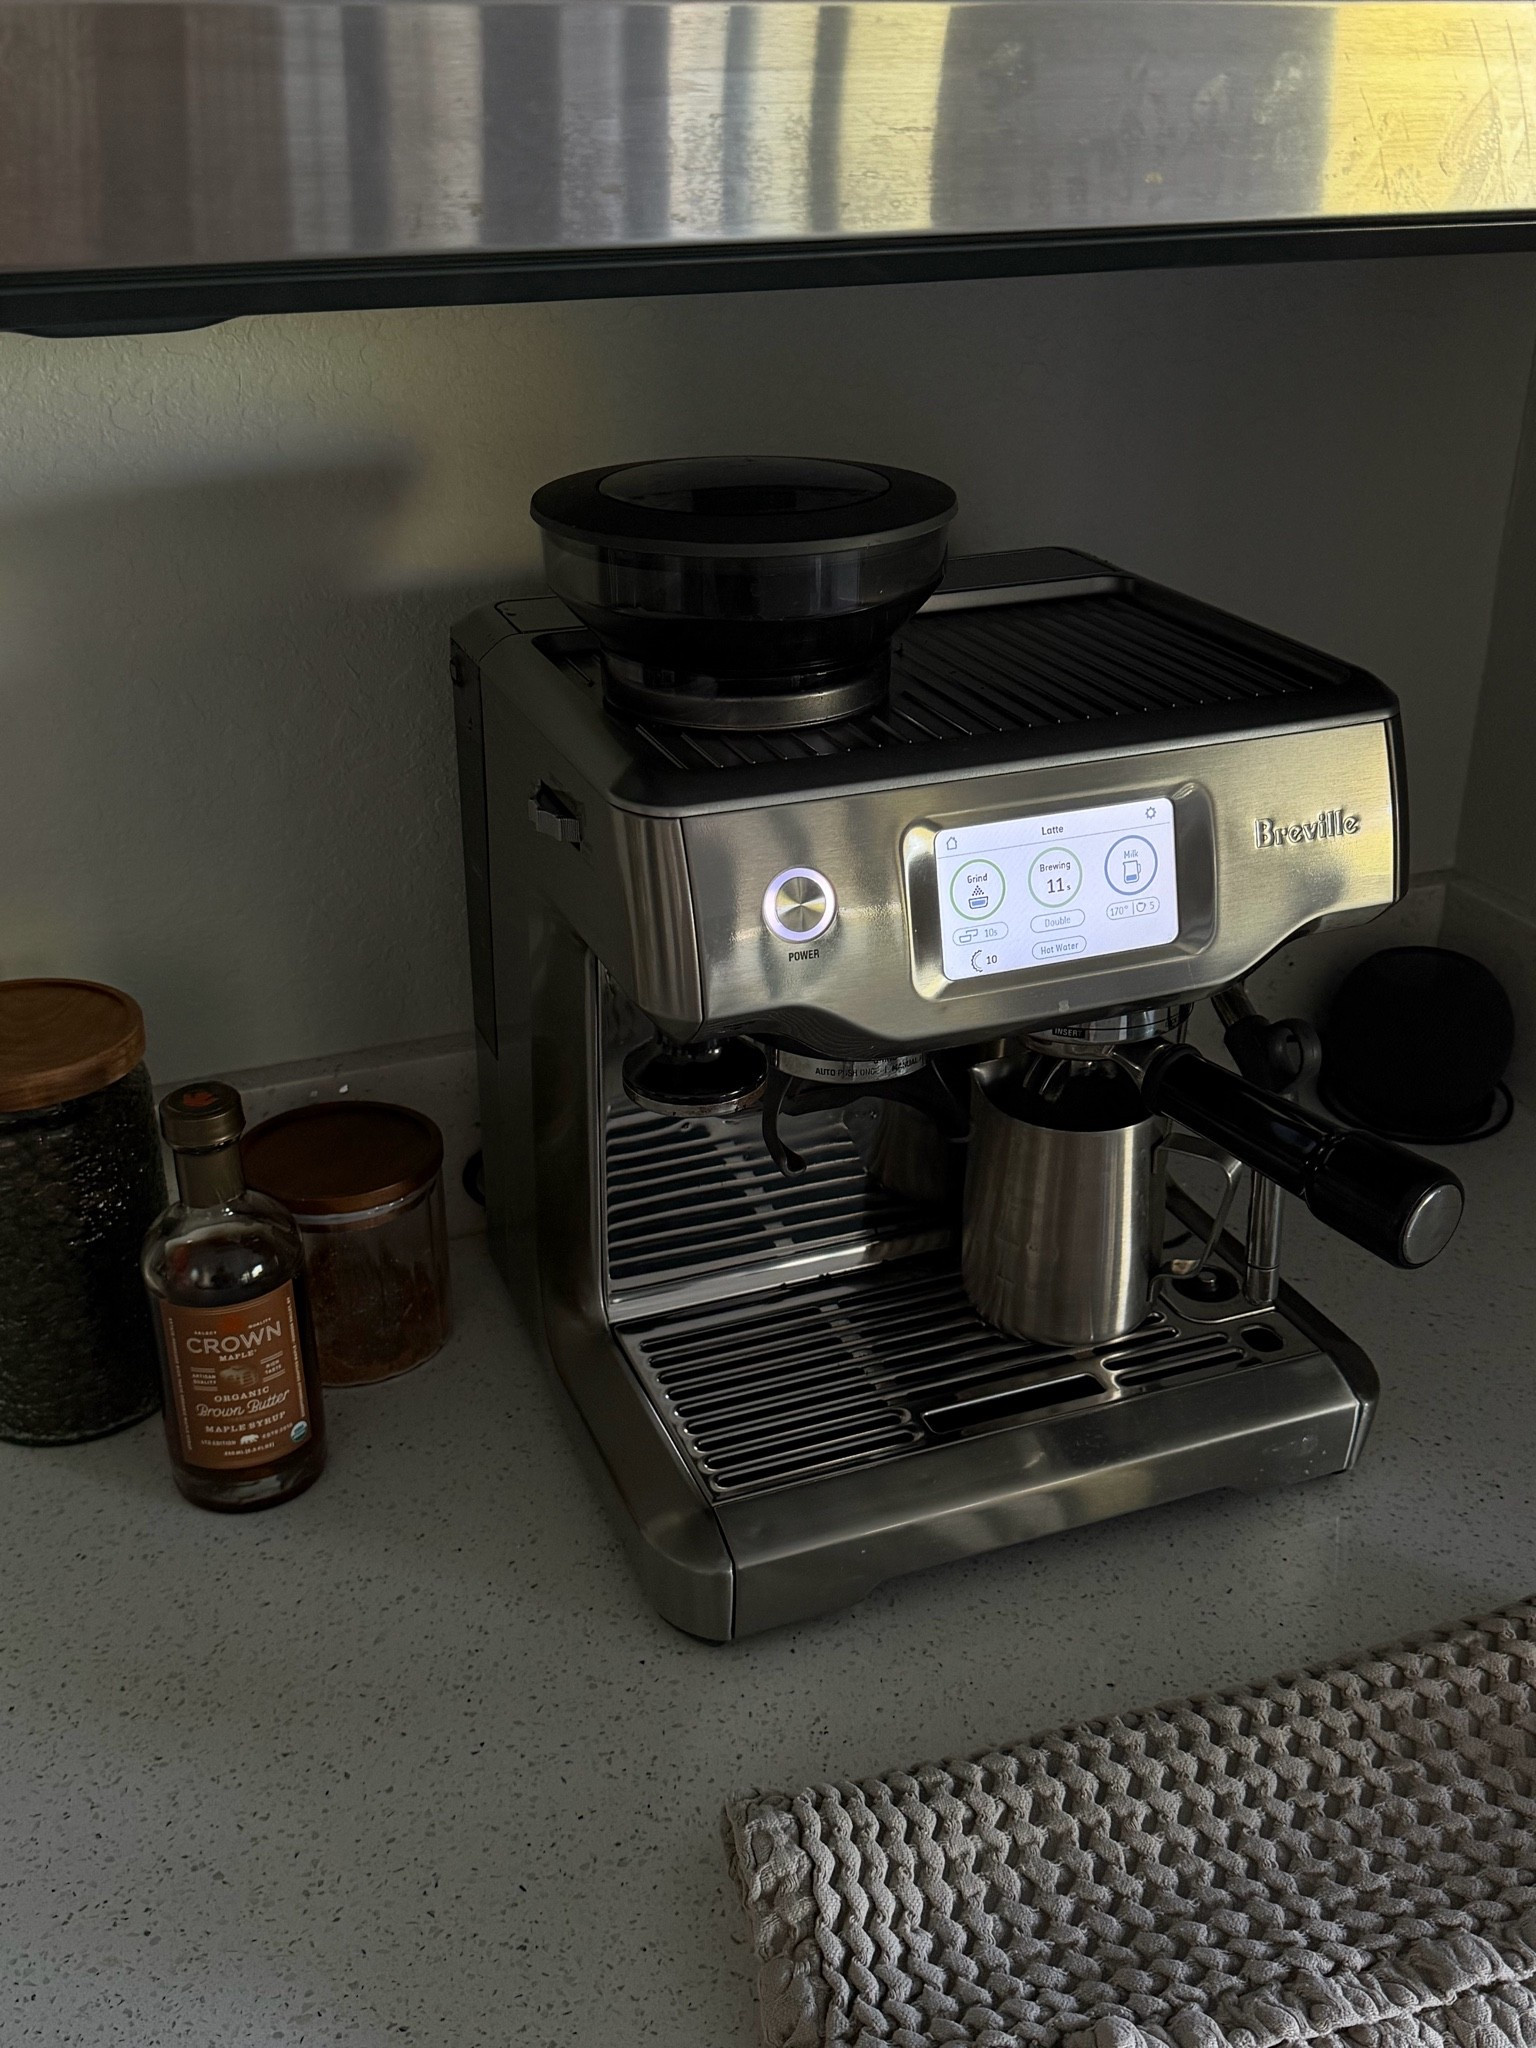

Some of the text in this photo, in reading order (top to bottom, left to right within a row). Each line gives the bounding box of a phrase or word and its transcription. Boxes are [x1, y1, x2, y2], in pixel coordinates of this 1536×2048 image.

[1041, 825, 1064, 836] Latte
[1254, 809, 1360, 848] Breville
[1123, 850, 1139, 859] Milk
[1039, 860, 1071, 873] Brewing
[967, 873, 988, 884] Grind
[1044, 915, 1071, 928] Double
[984, 928, 998, 938] 10s
[1040, 941, 1079, 955] Hot Water
[788, 949, 820, 962] POWER
[986, 954, 998, 965] 10
[1054, 1028, 1082, 1037] INSERT
[815, 1067, 836, 1077] AUTO
[838, 1069, 858, 1077] PUSH
[186, 1320, 282, 1354] CROWN
[214, 1386, 270, 1403] ORGANIC
[196, 1389, 290, 1418] Brown Butter
[205, 1411, 286, 1433] MAPLE SYRUP
